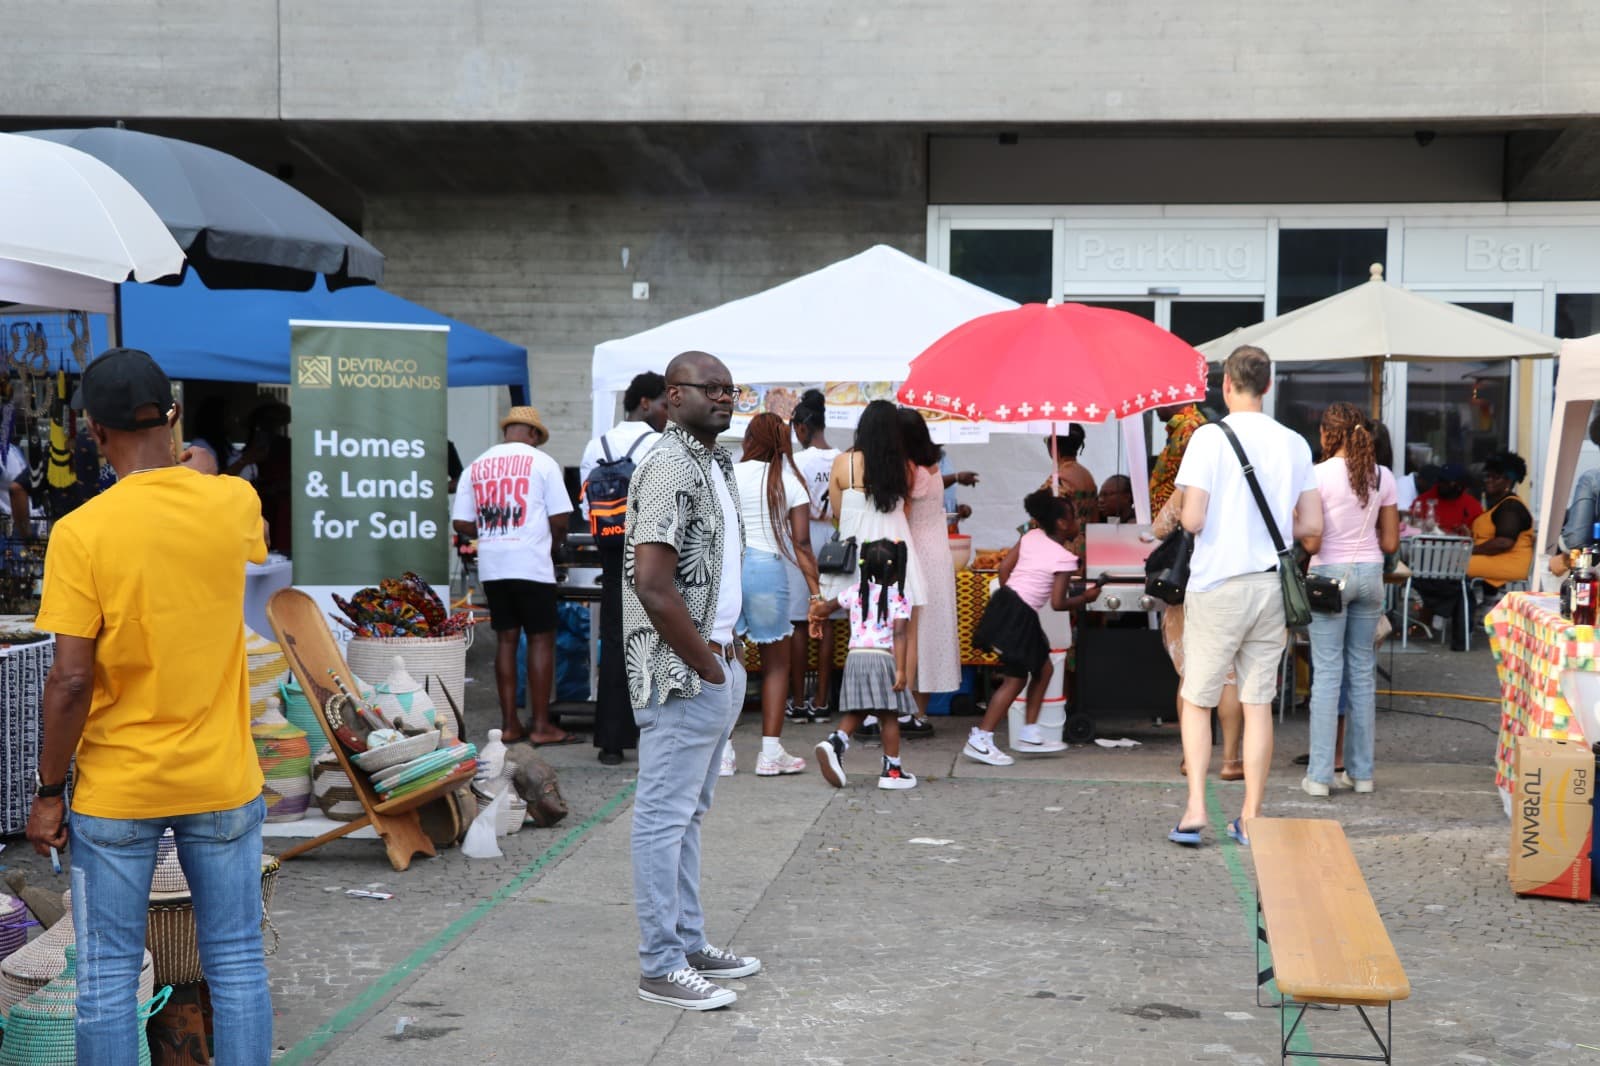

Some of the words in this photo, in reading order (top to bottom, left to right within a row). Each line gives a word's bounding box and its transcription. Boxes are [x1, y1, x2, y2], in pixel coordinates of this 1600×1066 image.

[1076, 233, 1252, 280] Parking
[1464, 233, 1552, 273] Bar
[338, 357, 417, 374] DEVTRACO
[338, 373, 441, 390] WOODLANDS
[314, 429, 426, 459] Homes
[471, 455, 534, 482] RESERVOIR
[305, 470, 329, 498] &
[341, 470, 434, 499] Lands
[312, 510, 360, 539] for
[369, 511, 438, 539] Sale
[1573, 768, 1587, 796] P50
[1522, 767, 1542, 859] TURBANA
